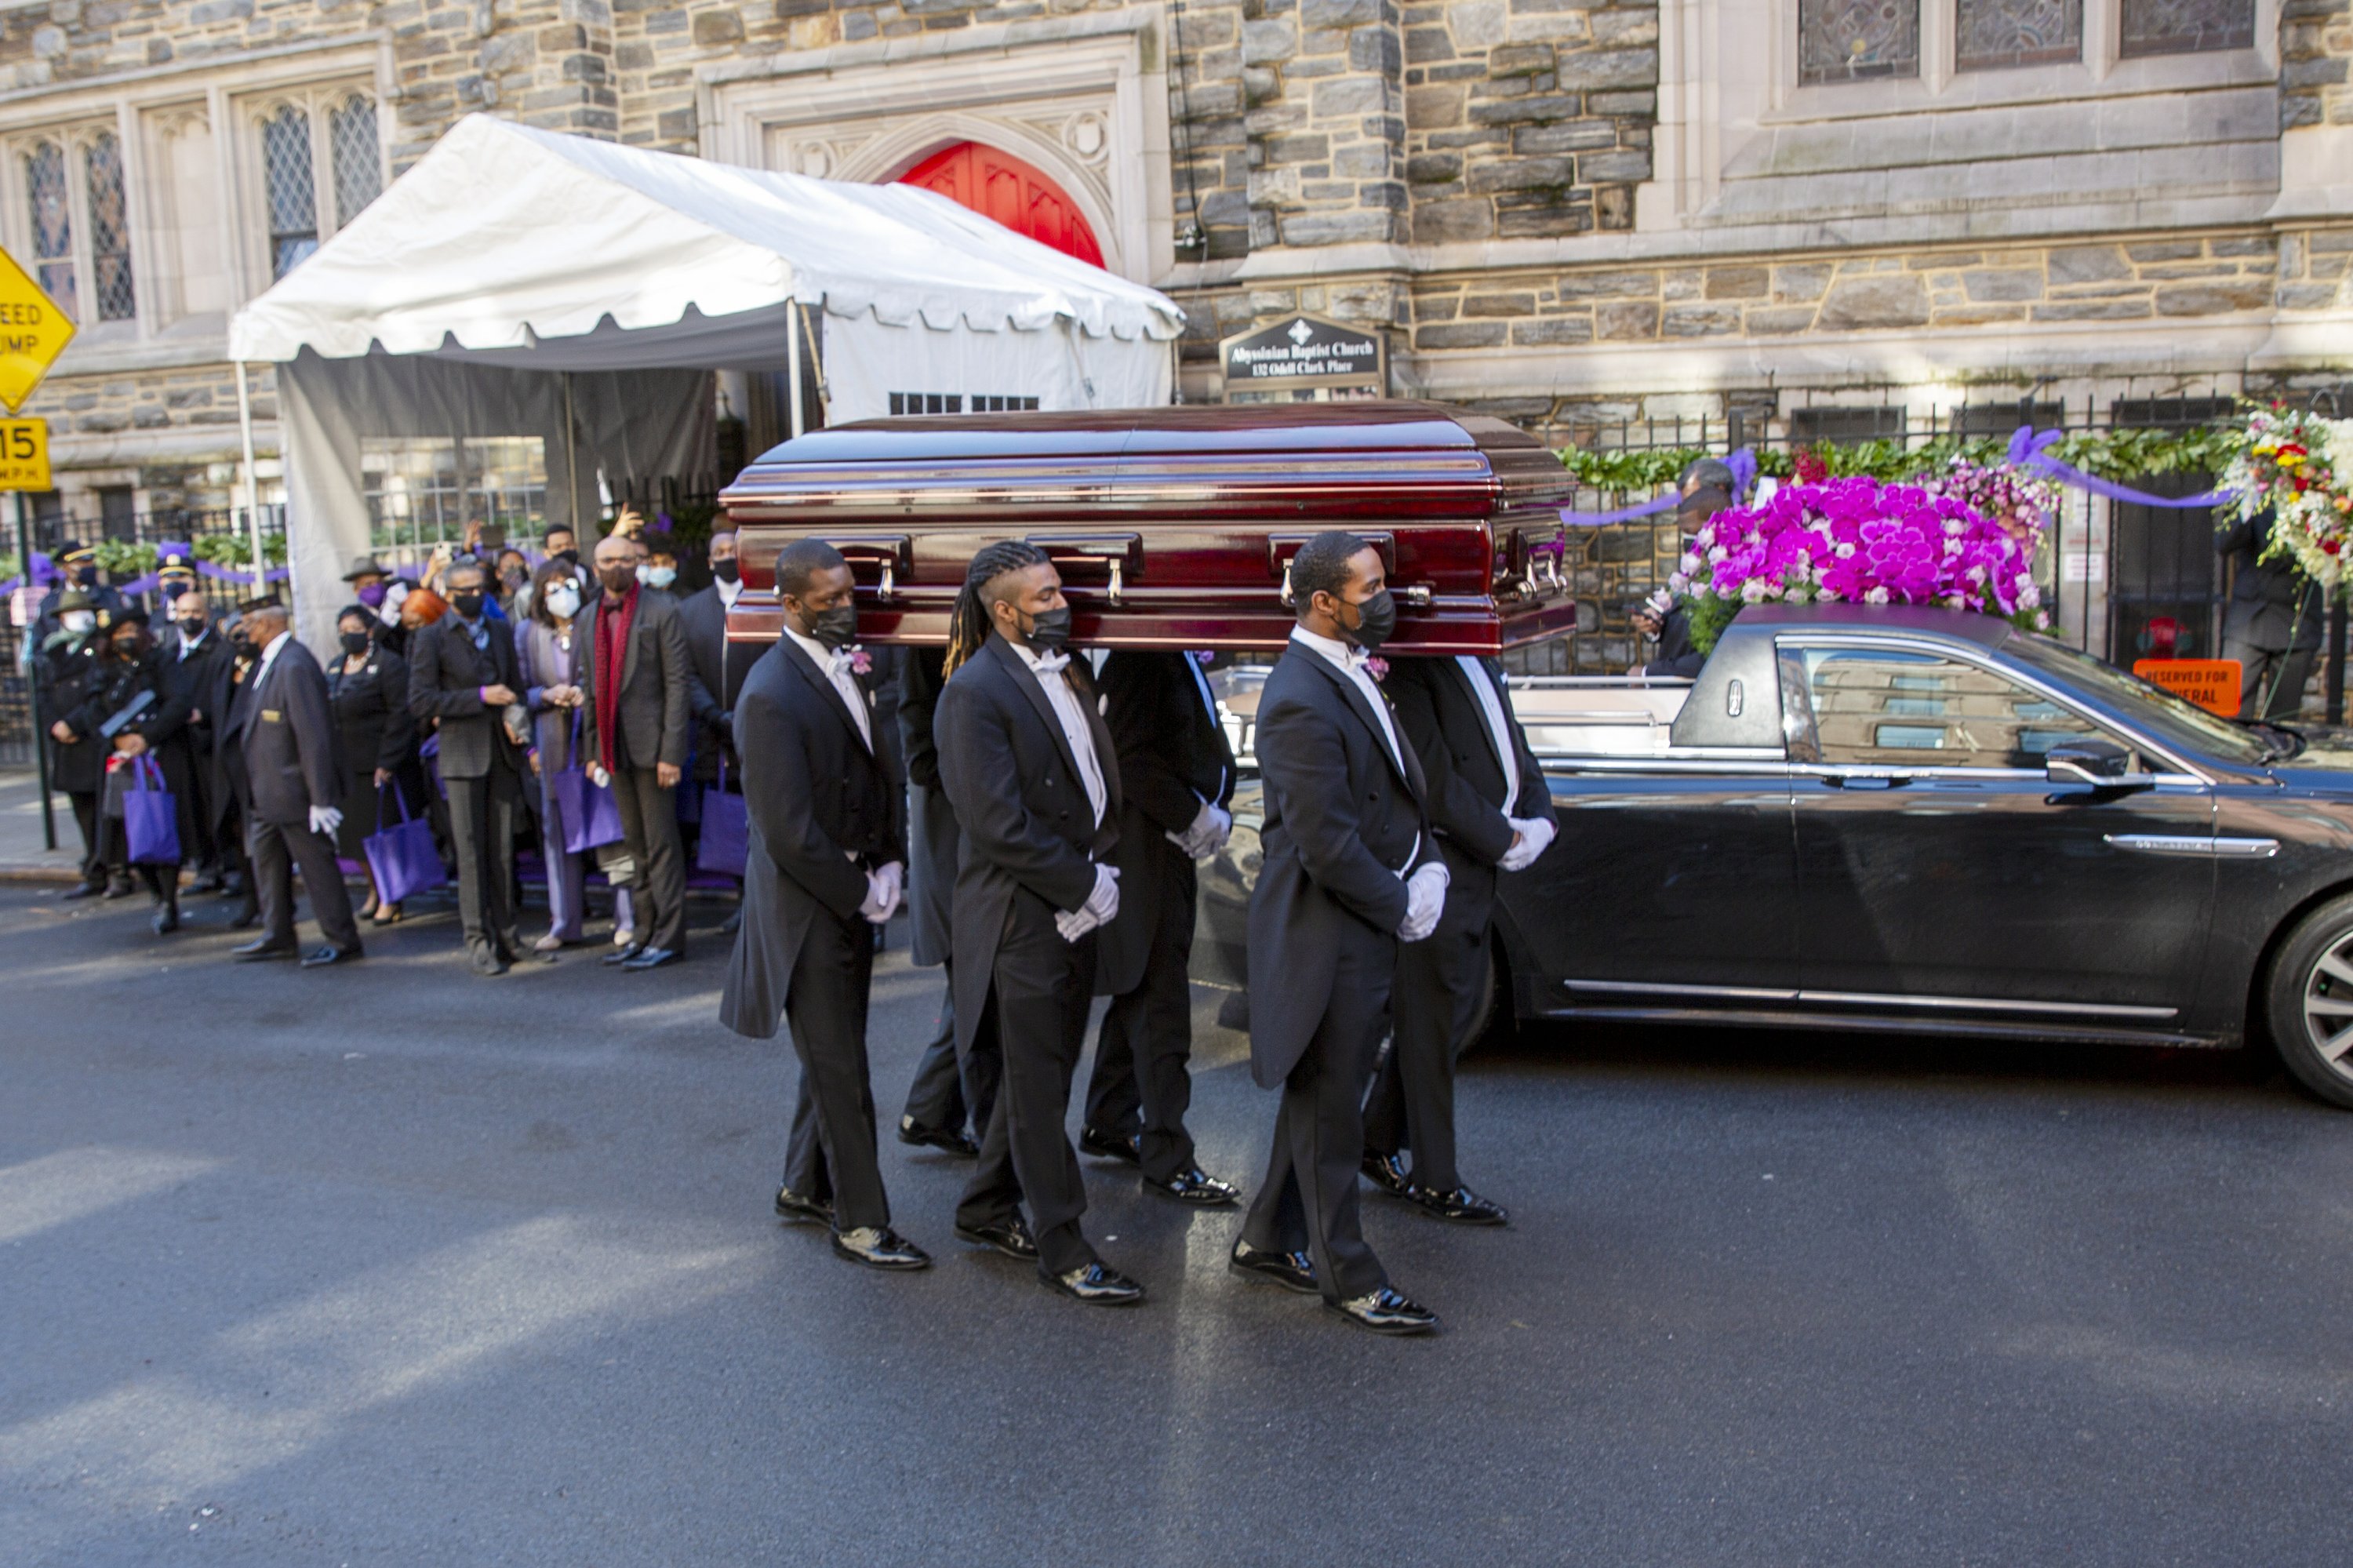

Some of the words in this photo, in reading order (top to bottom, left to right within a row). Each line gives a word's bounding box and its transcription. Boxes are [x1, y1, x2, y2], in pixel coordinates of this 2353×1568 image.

[0, 303, 42, 326] EED
[1291, 343, 1330, 361] Baptist
[1332, 340, 1374, 356] Church
[1297, 360, 1326, 374] Clark
[1327, 359, 1354, 373] Place
[0, 427, 36, 460] 15
[2145, 671, 2202, 683] RESERVED
[2206, 671, 2228, 682] FOR
